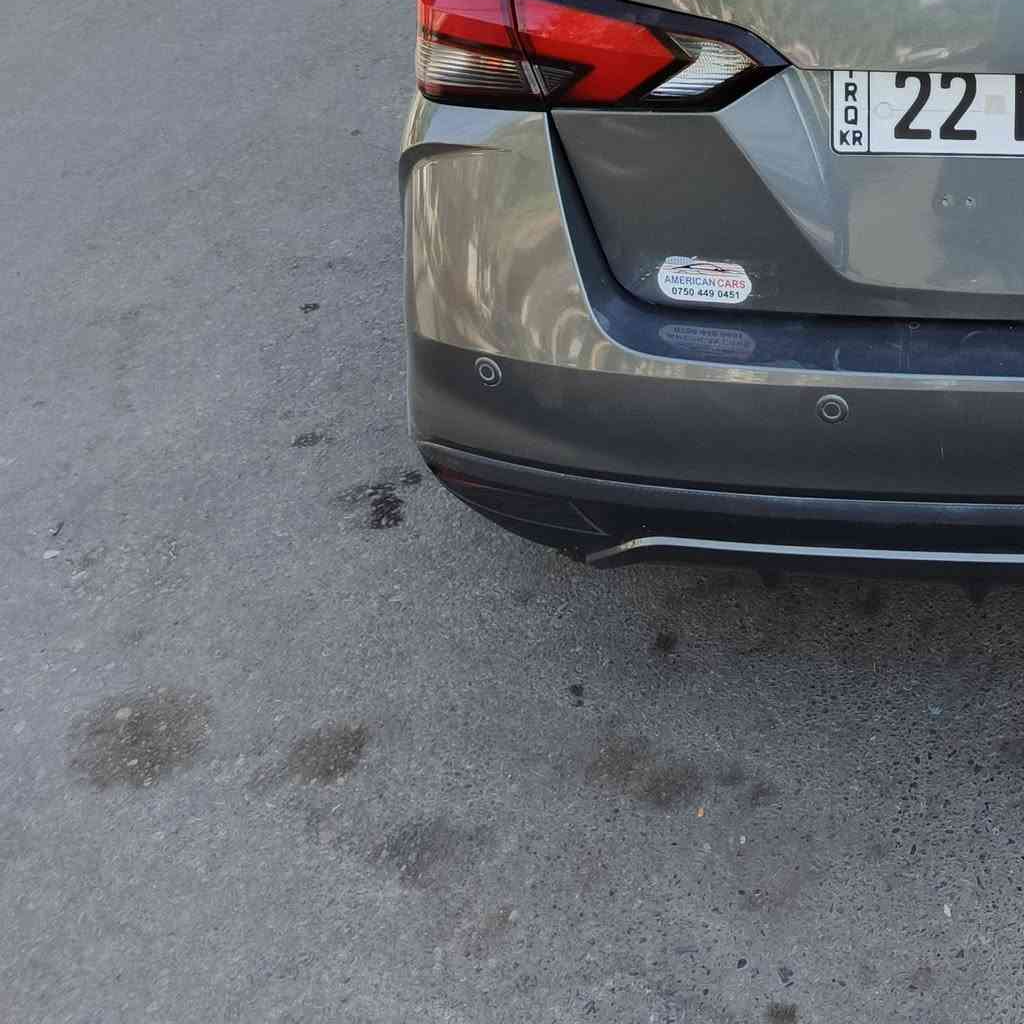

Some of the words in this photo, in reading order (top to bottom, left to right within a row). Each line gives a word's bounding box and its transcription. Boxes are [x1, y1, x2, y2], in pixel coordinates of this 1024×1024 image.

[894, 71, 977, 141] 22
[664, 275, 716, 287] AMERICAN
[717, 278, 746, 289] CARS
[671, 286, 695, 297] 0750
[697, 288, 714, 298] 449
[717, 289, 740, 299] 0451
